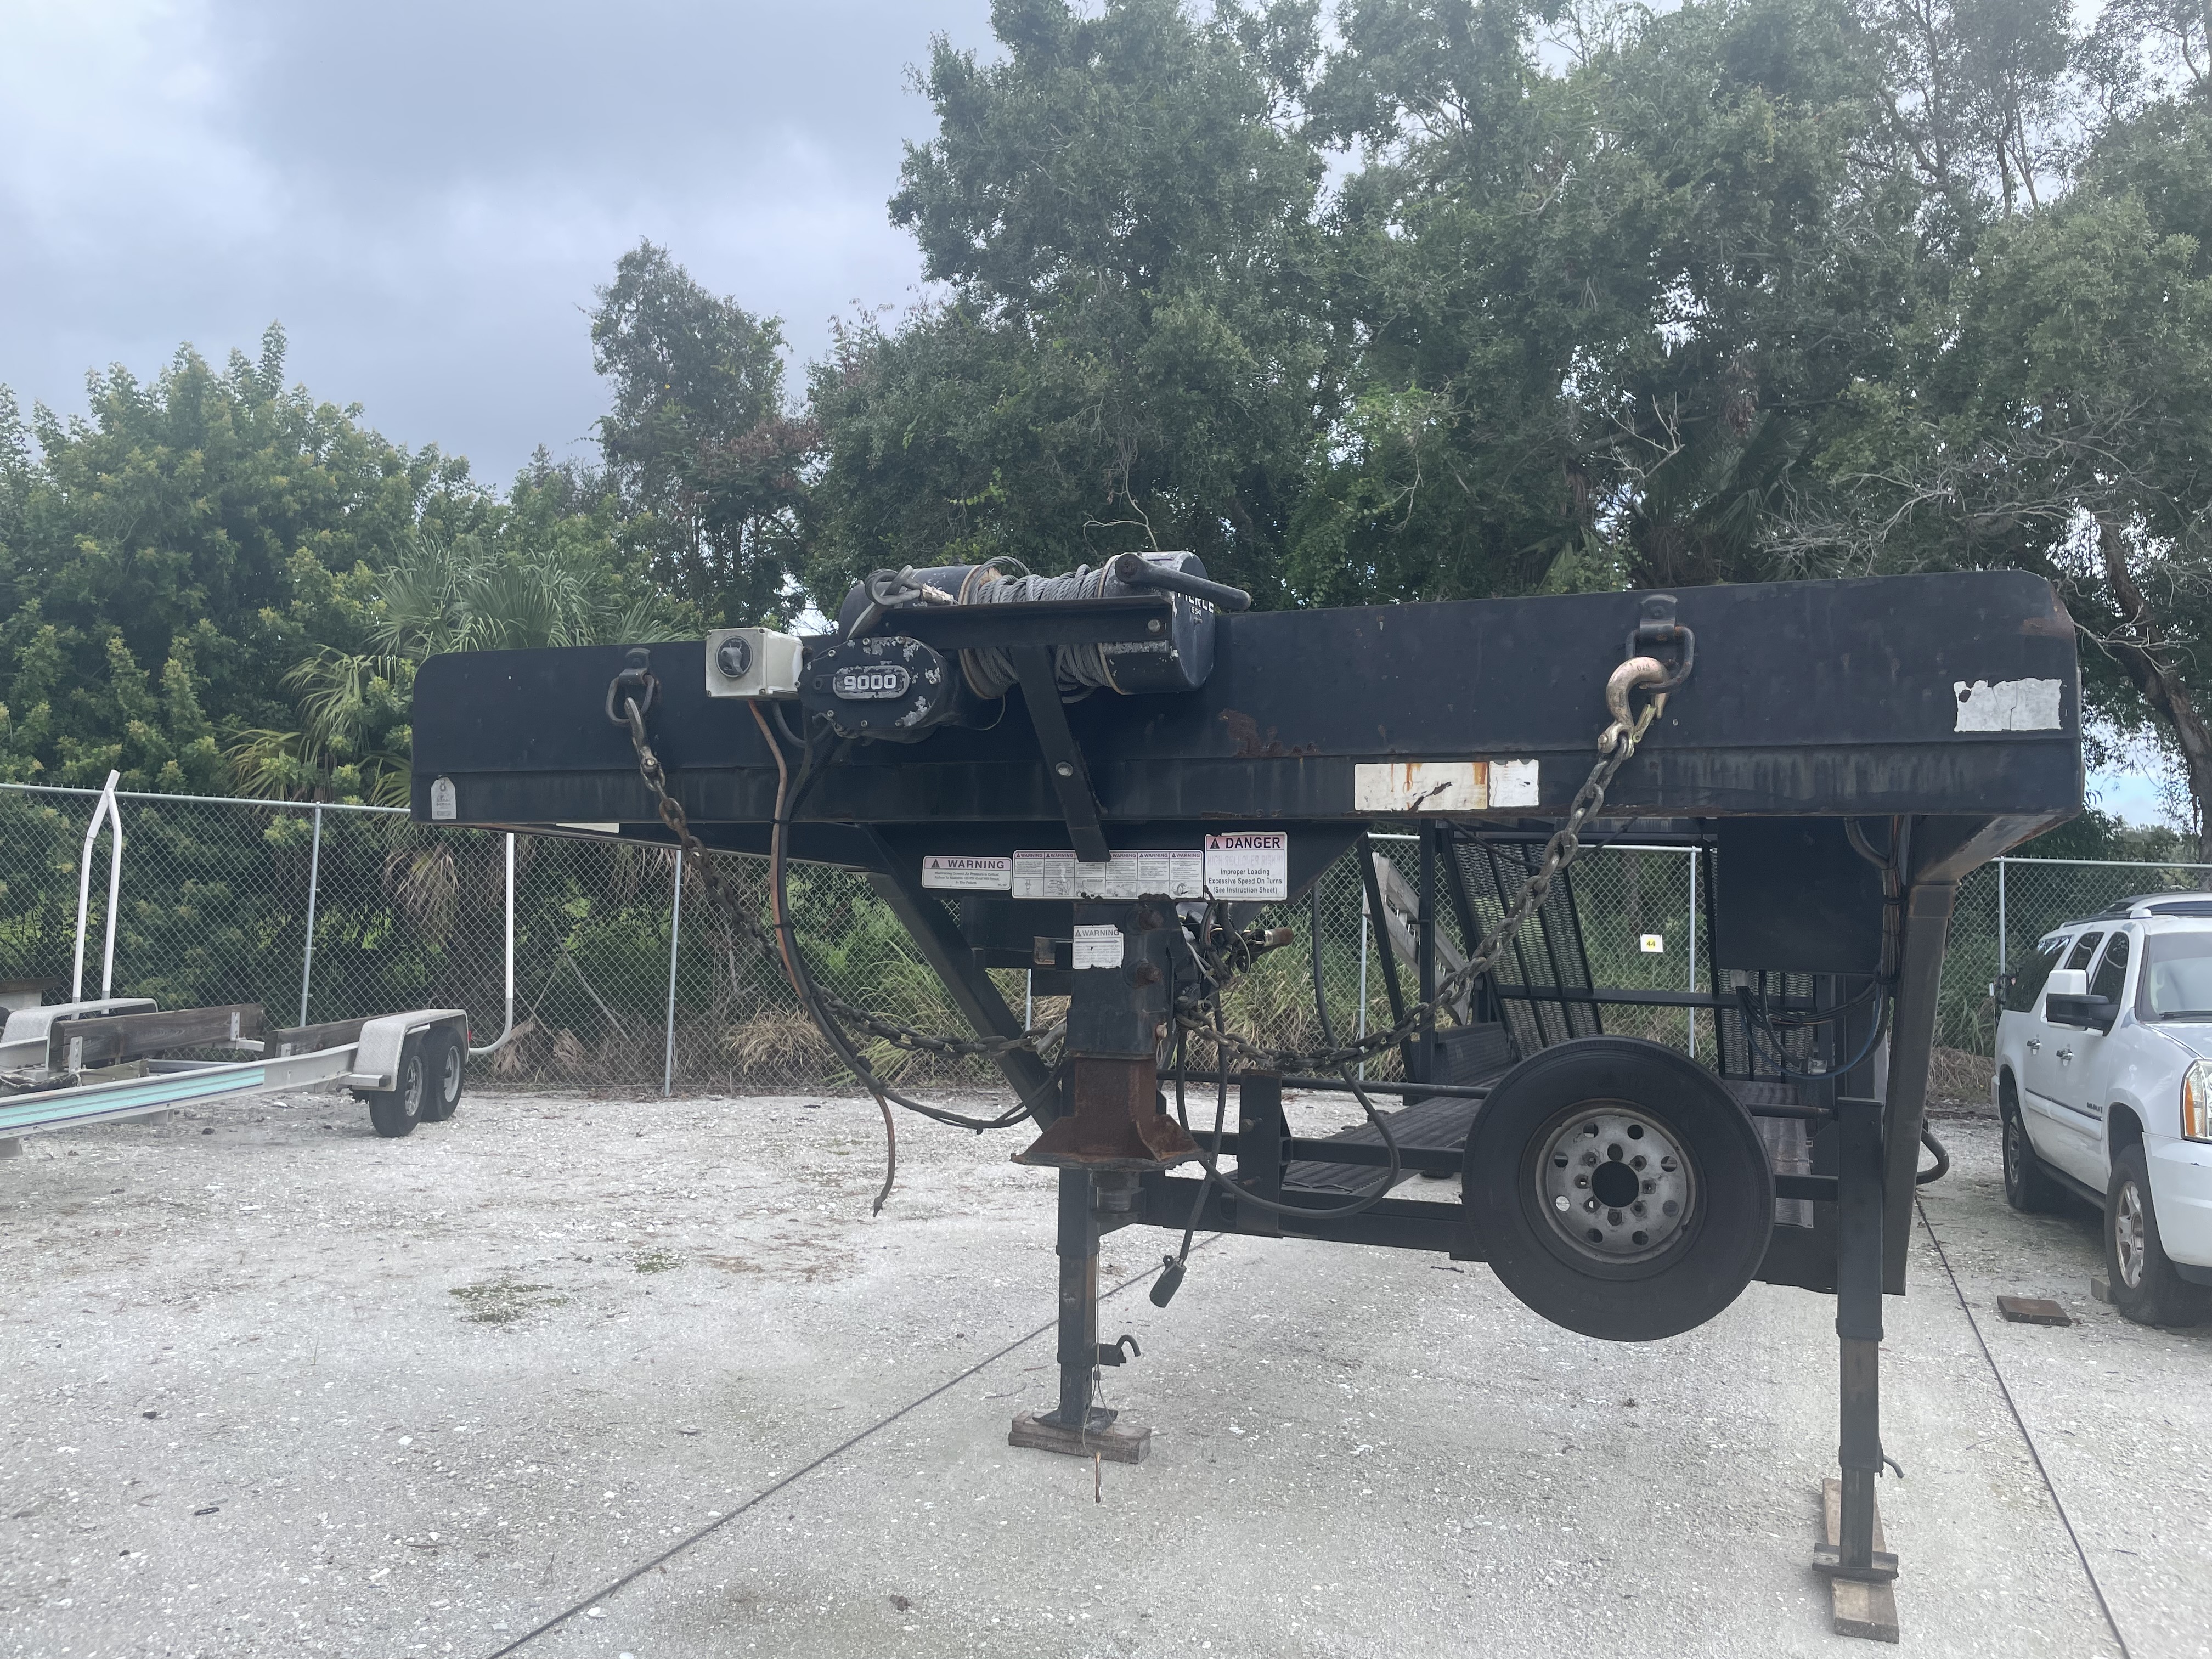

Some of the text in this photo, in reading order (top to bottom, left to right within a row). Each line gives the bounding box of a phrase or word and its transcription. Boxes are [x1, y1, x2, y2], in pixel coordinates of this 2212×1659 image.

[844, 674, 896, 690] 9000
[1226, 837, 1280, 849] DANGER
[947, 859, 1005, 869] WARNING
[1247, 868, 1270, 876] Loading
[1238, 877, 1255, 885] Speed
